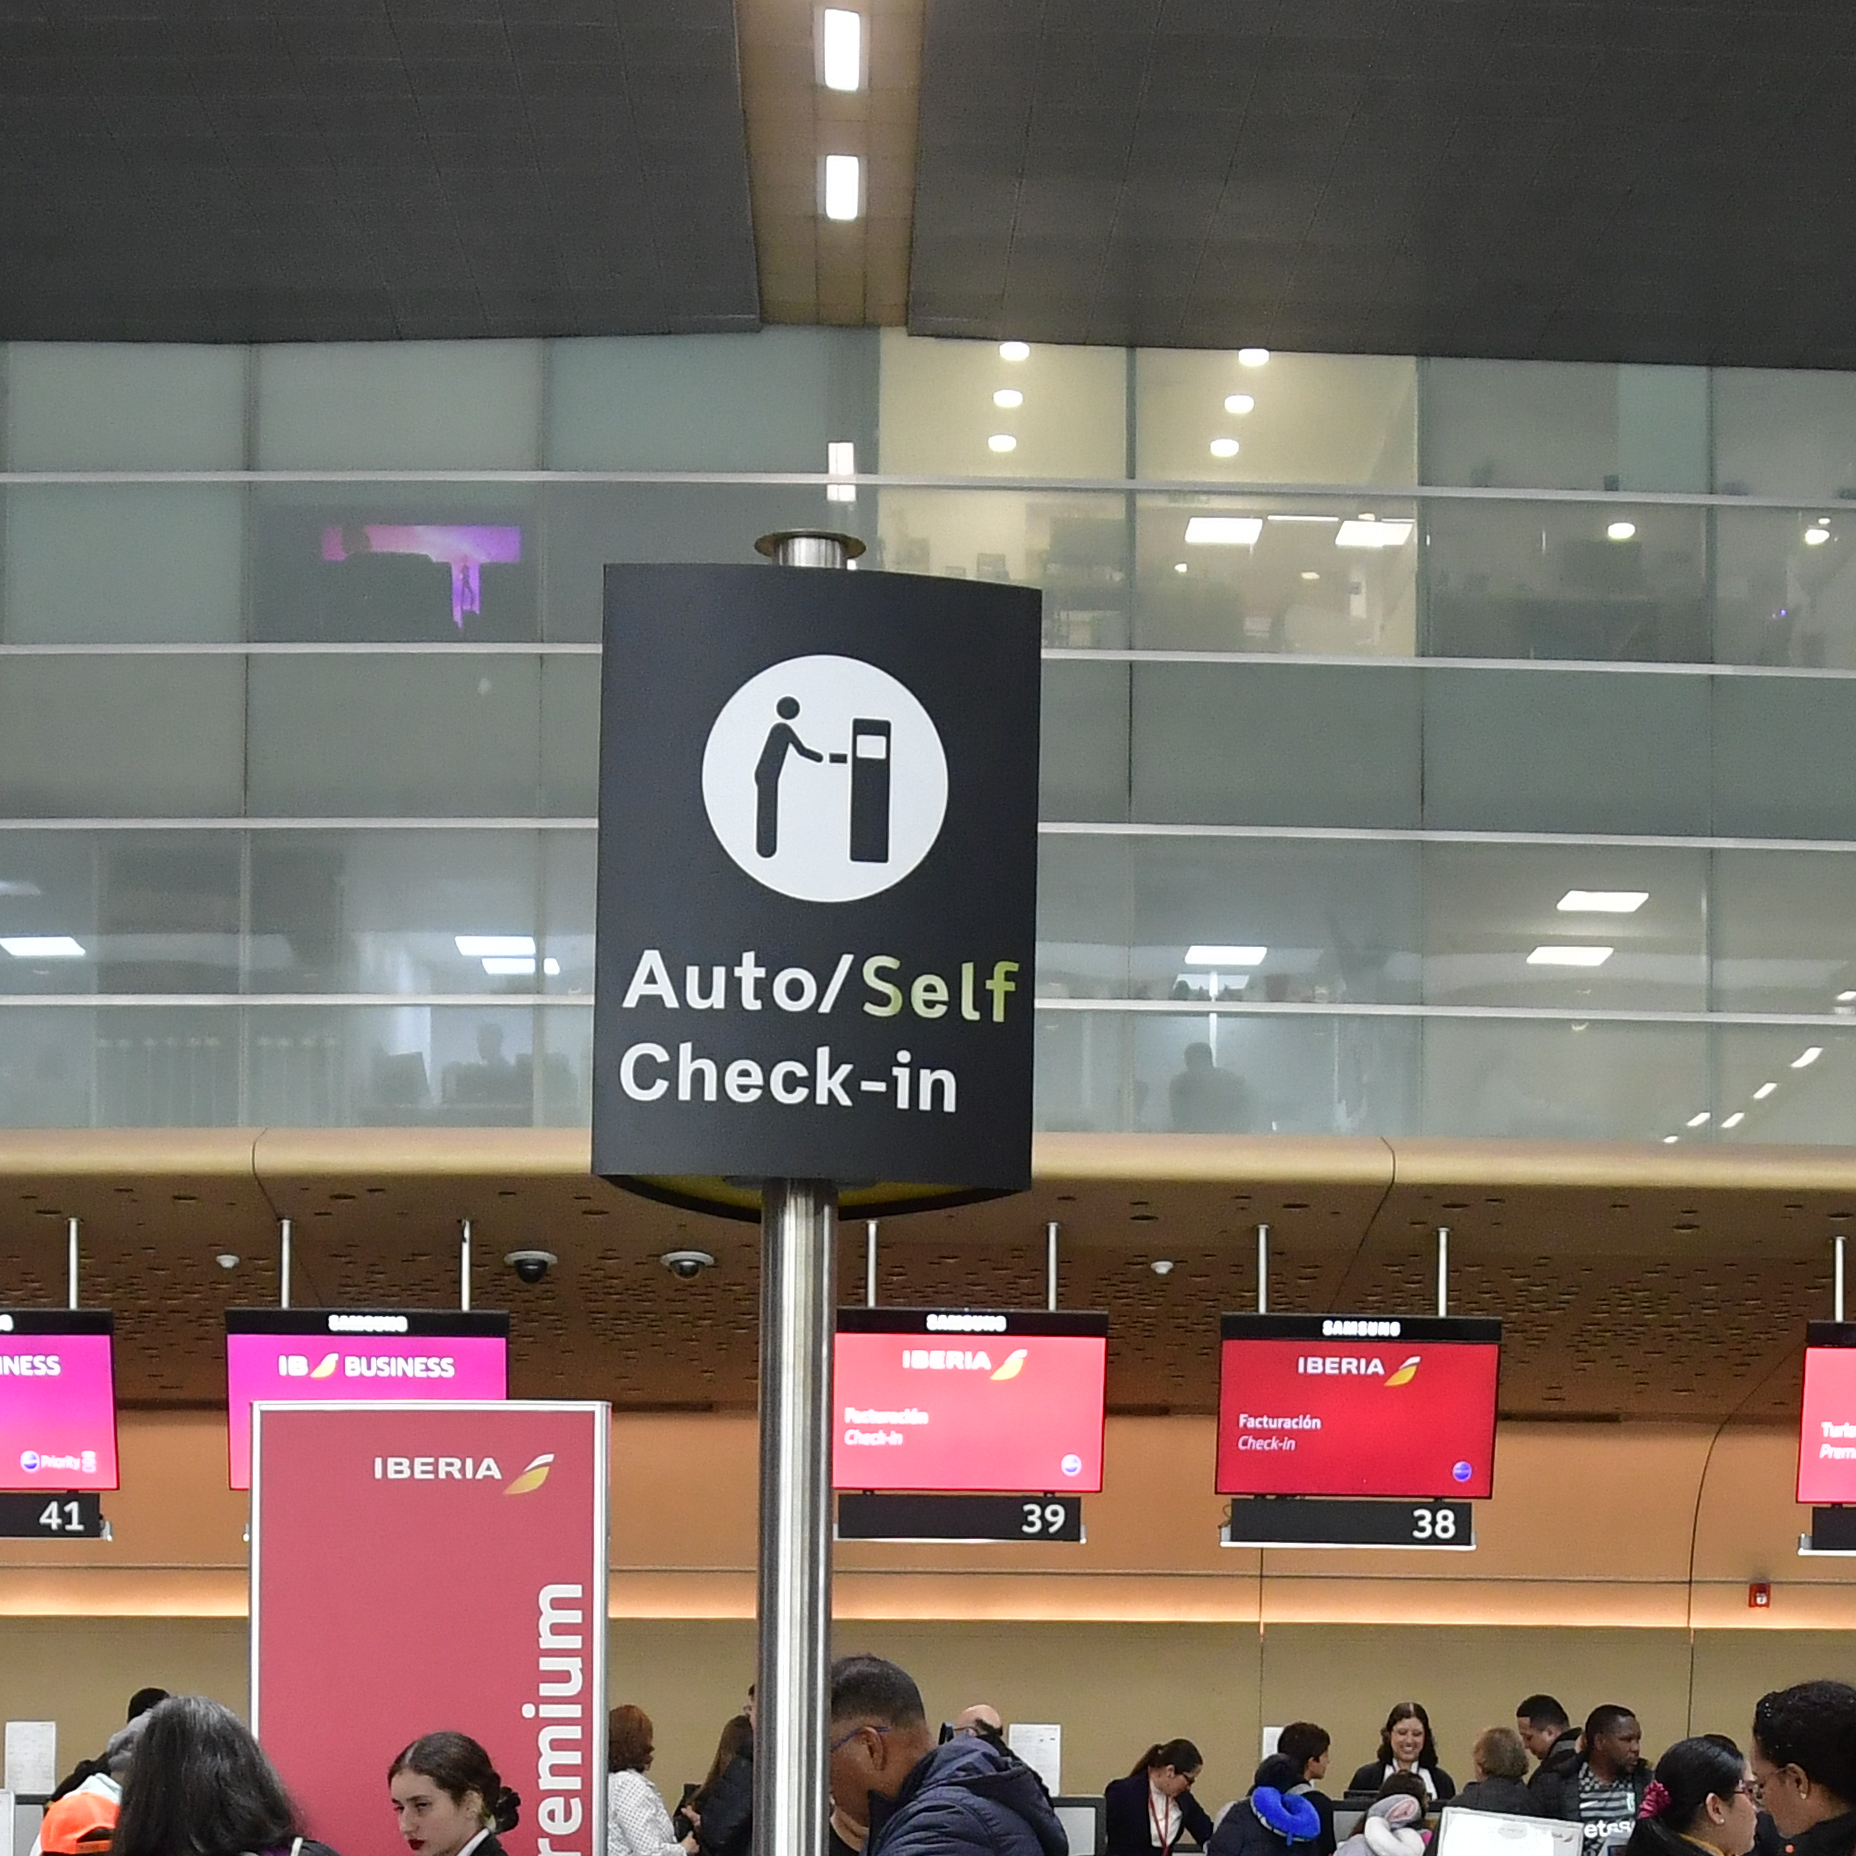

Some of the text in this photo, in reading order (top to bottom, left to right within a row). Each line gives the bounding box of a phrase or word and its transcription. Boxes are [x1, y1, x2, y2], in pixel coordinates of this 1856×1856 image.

[622, 949, 1019, 1022] Auto/Self
[619, 1043, 957, 1113] Check-in
[1322, 1320, 1401, 1337] SAMSUNG
[278, 1355, 455, 1378] IB BUSINESS
[902, 1350, 992, 1370] IBERIA
[1298, 1357, 1385, 1375] IBERIA
[1239, 1414, 1321, 1430] Facturación
[1238, 1436, 1296, 1452] Check-in
[374, 1457, 502, 1480] IBERIA
[39, 1501, 84, 1530] 41
[1021, 1504, 1065, 1534] 39
[1412, 1509, 1456, 1539] 38
